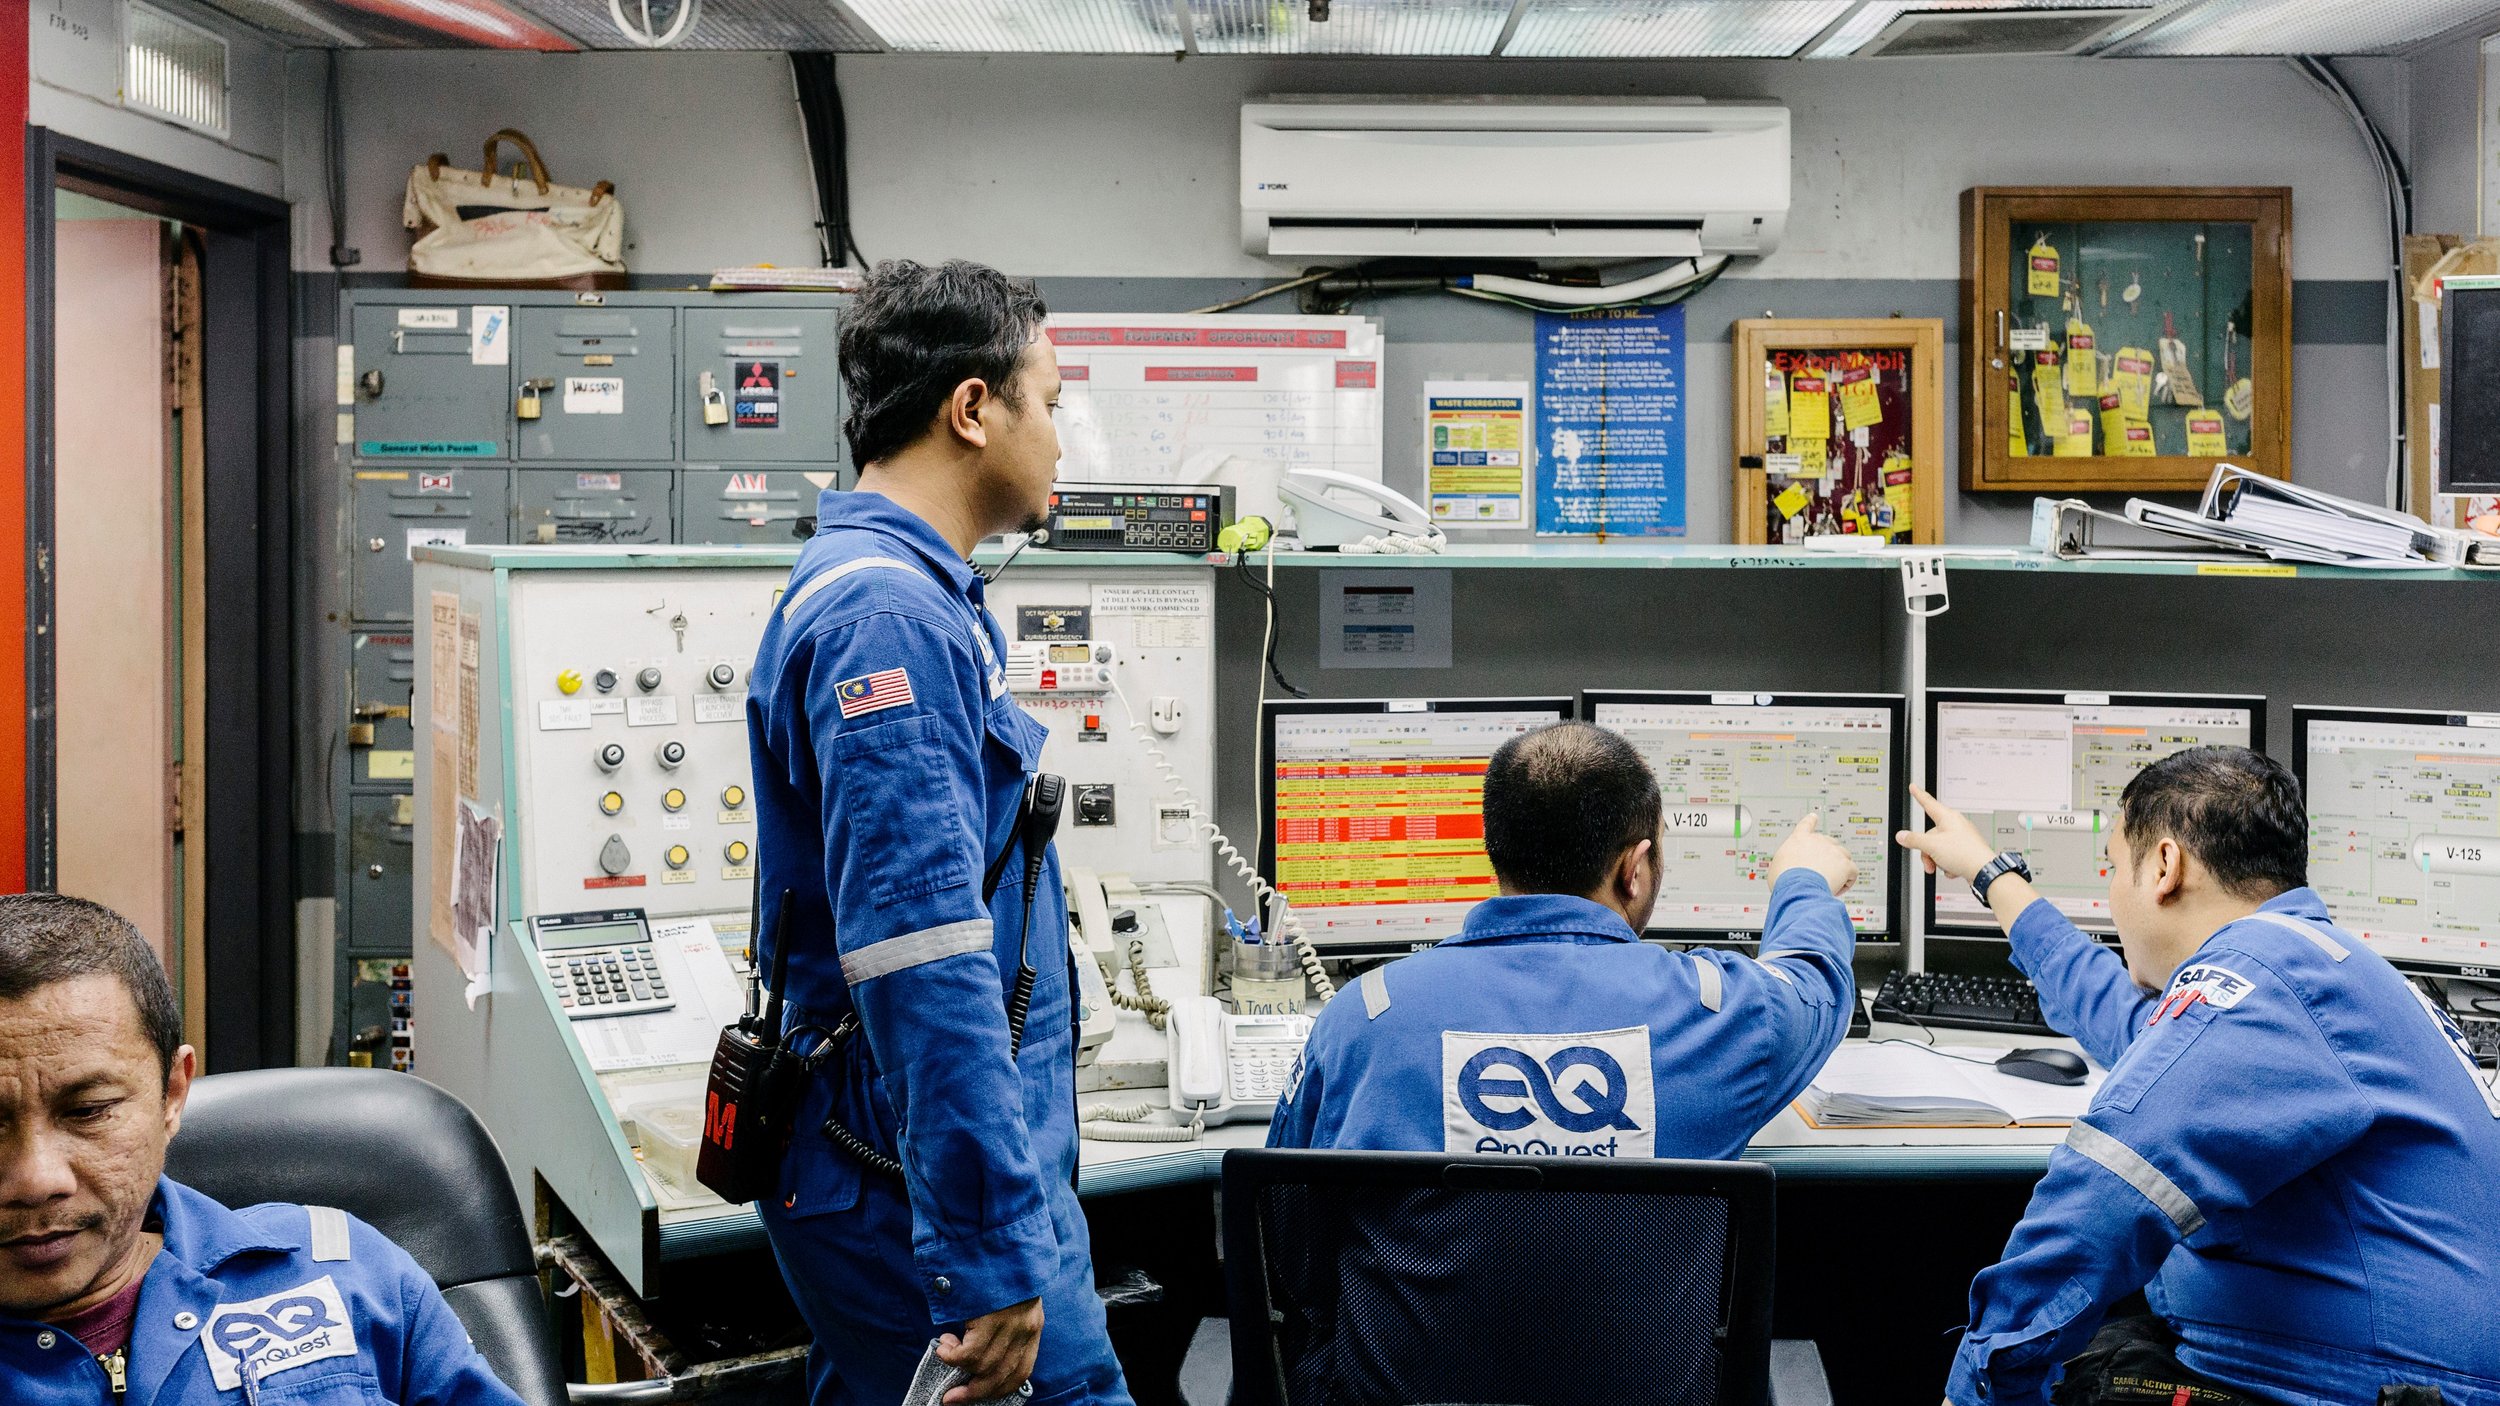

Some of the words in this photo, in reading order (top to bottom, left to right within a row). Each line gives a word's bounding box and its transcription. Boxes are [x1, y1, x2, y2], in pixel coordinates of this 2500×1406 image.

[1608, 309, 1620, 318] TO
[1056, 330, 1111, 341] CRITICAL
[1124, 330, 1198, 342] EQUIPMENT
[1208, 332, 1295, 344] OPPORTUNITY
[1308, 333, 1333, 344] LIST
[1774, 351, 1904, 378] ExxonMobil
[1463, 400, 1517, 408] SEGREGATION
[380, 443, 418, 454] General
[420, 442, 444, 453] Work
[446, 443, 478, 453] Permit
[640, 698, 663, 706] BYPASS
[1673, 812, 1708, 828] V-120
[2446, 846, 2482, 862] V-125
[1728, 932, 1751, 941] DELL
[2461, 966, 2489, 977] DELL
[2175, 968, 2248, 996] SAFE
[704, 1090, 737, 1150] M
[1475, 1136, 1619, 1158] enQuest
[2113, 1376, 2140, 1386] CAMEL
[2141, 1378, 2174, 1391] ACTIVE
